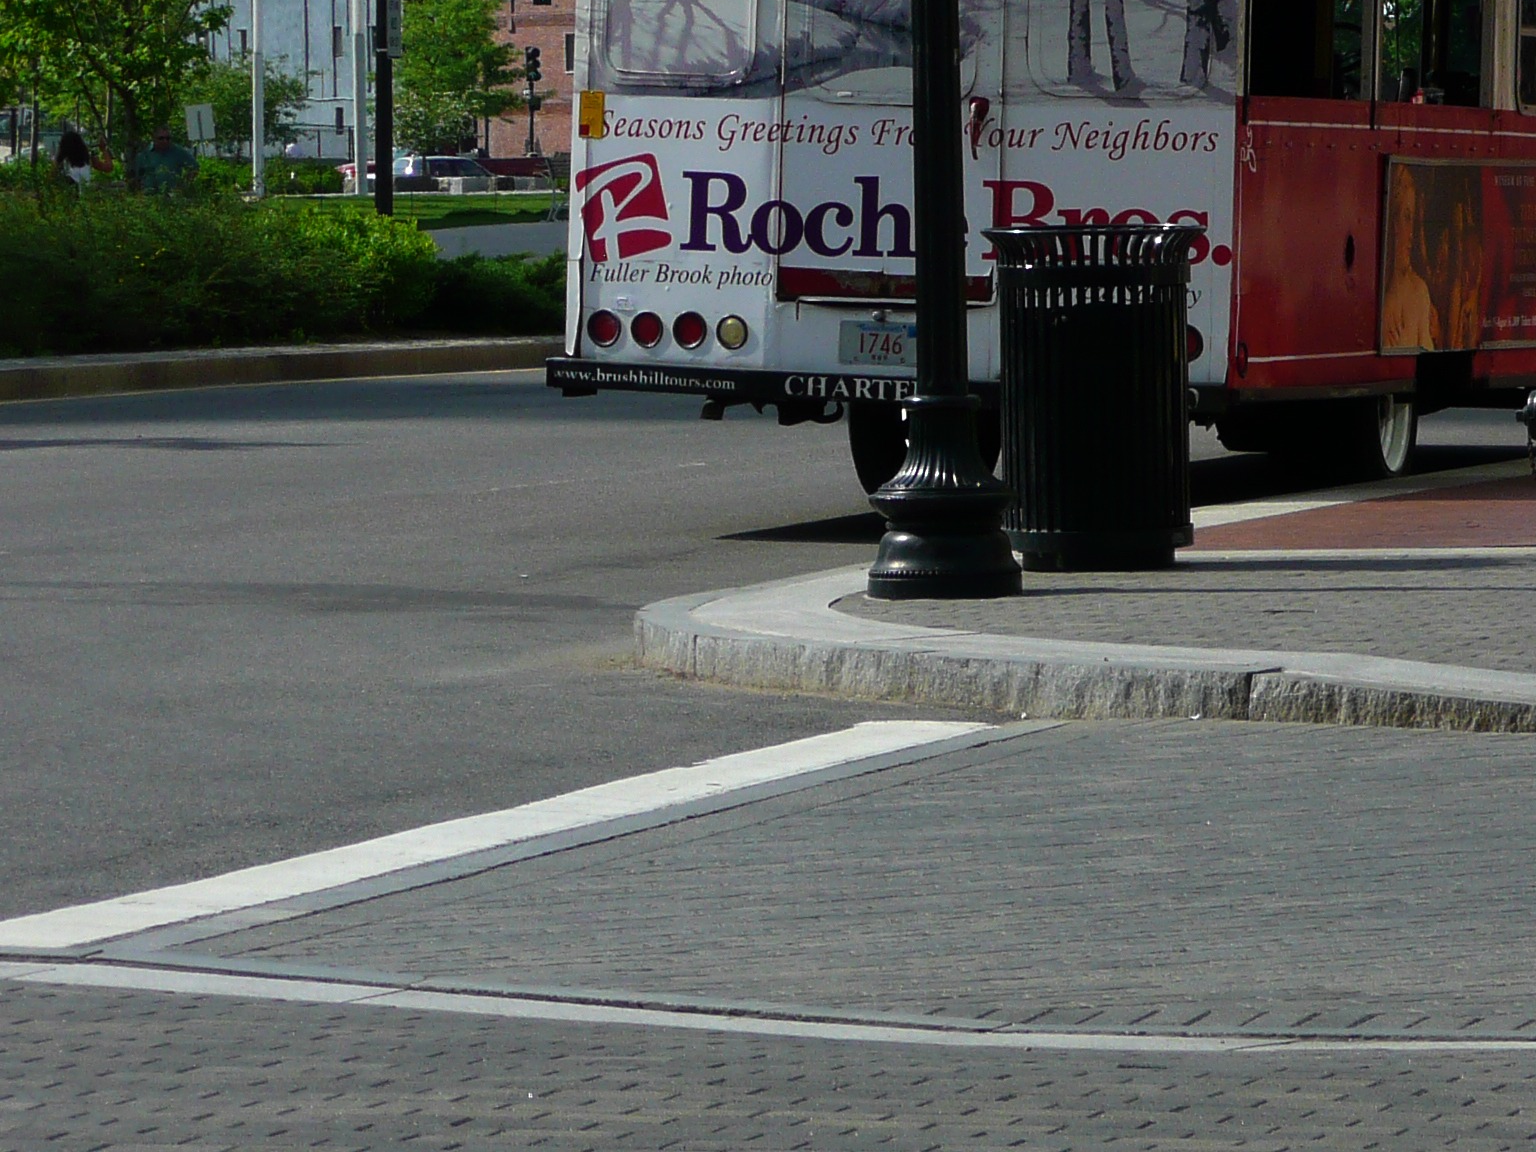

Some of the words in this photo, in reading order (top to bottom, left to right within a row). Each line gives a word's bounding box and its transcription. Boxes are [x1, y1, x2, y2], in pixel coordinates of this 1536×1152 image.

[603, 109, 706, 140] Seasons
[717, 113, 860, 156] Greetings
[871, 118, 915, 147] Fr
[1050, 118, 1220, 161] Neighbors
[679, 170, 969, 257] Roch
[589, 262, 651, 284] Fuller
[654, 263, 713, 284] Brook
[716, 265, 774, 290] photo
[860, 332, 903, 355] 1746
[552, 367, 736, 391] www.brushhilltours.com
[784, 374, 917, 401] CHARTE
